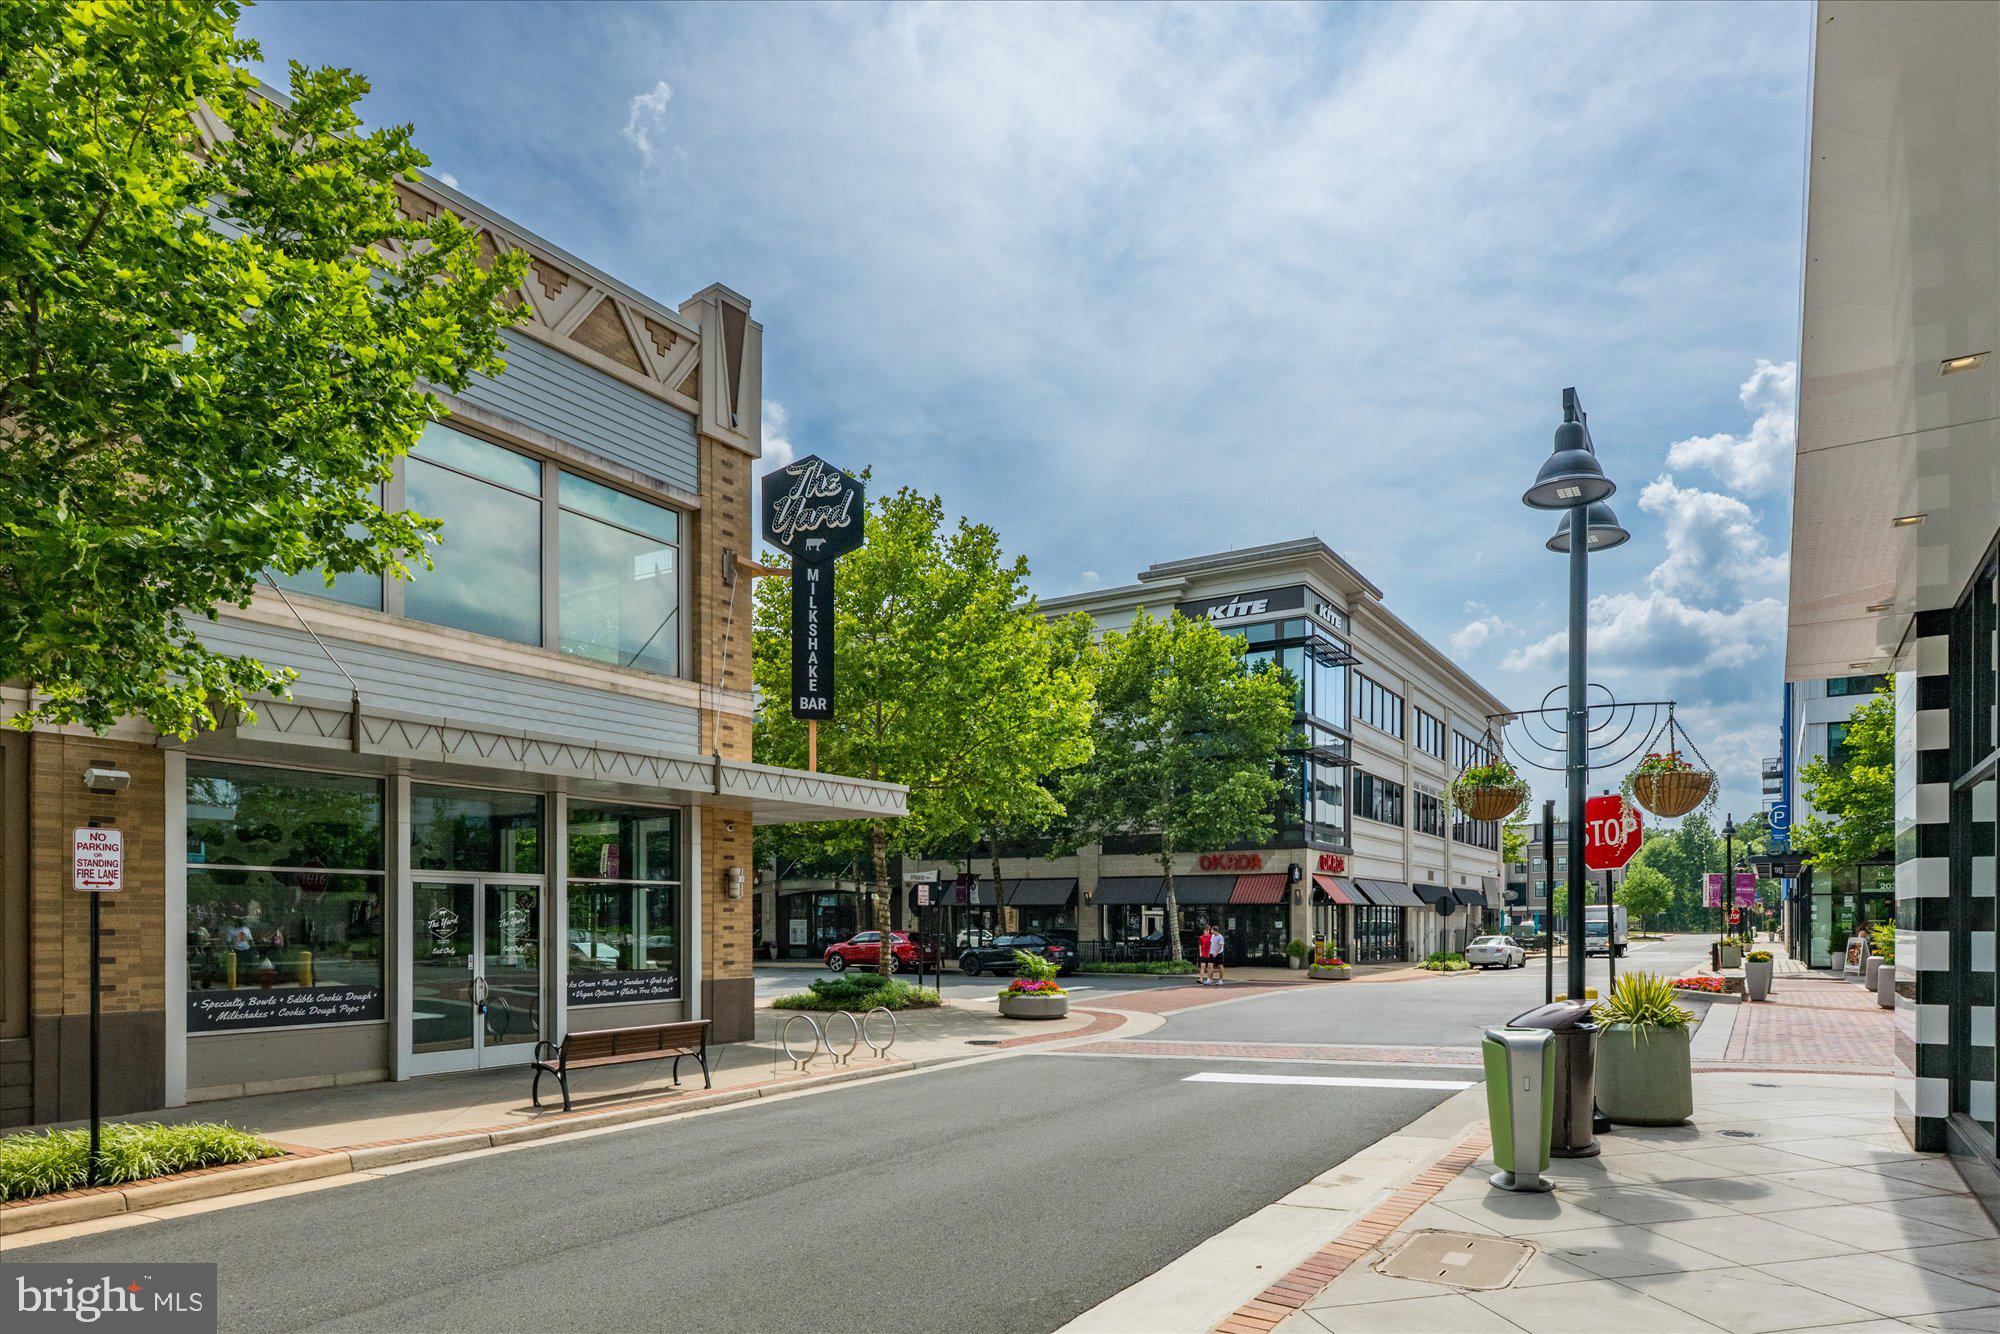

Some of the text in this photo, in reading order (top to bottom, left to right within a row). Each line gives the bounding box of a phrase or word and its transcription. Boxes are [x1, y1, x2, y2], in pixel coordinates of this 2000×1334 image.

[787, 460, 842, 500] The
[772, 488, 854, 546] Yard
[807, 568, 819, 692] MILKSHAKE
[800, 697, 827, 711] BAR
[1774, 811, 1785, 824] P
[90, 833, 107, 842] NO
[1585, 818, 1638, 847] TOP
[77, 842, 119, 852] PARKING
[77, 859, 119, 868] STANDING
[1199, 853, 1262, 872] OKADA
[77, 869, 119, 879] FIRE LANE
[428, 915, 459, 929] The Yard
[499, 914, 527, 928] The Yard
[577, 980, 596, 988] Cream
[601, 978, 618, 987] Floats
[623, 977, 645, 986] Sundaes
[650, 976, 662, 986] Grab
[576, 986, 670, 1000] Vegan Options Gluten Free Options
[200, 990, 372, 1012] Specialty Bowls Edible Cookie Dough
[215, 1004, 360, 1022] Milkshakes Cookie Dough Pops
